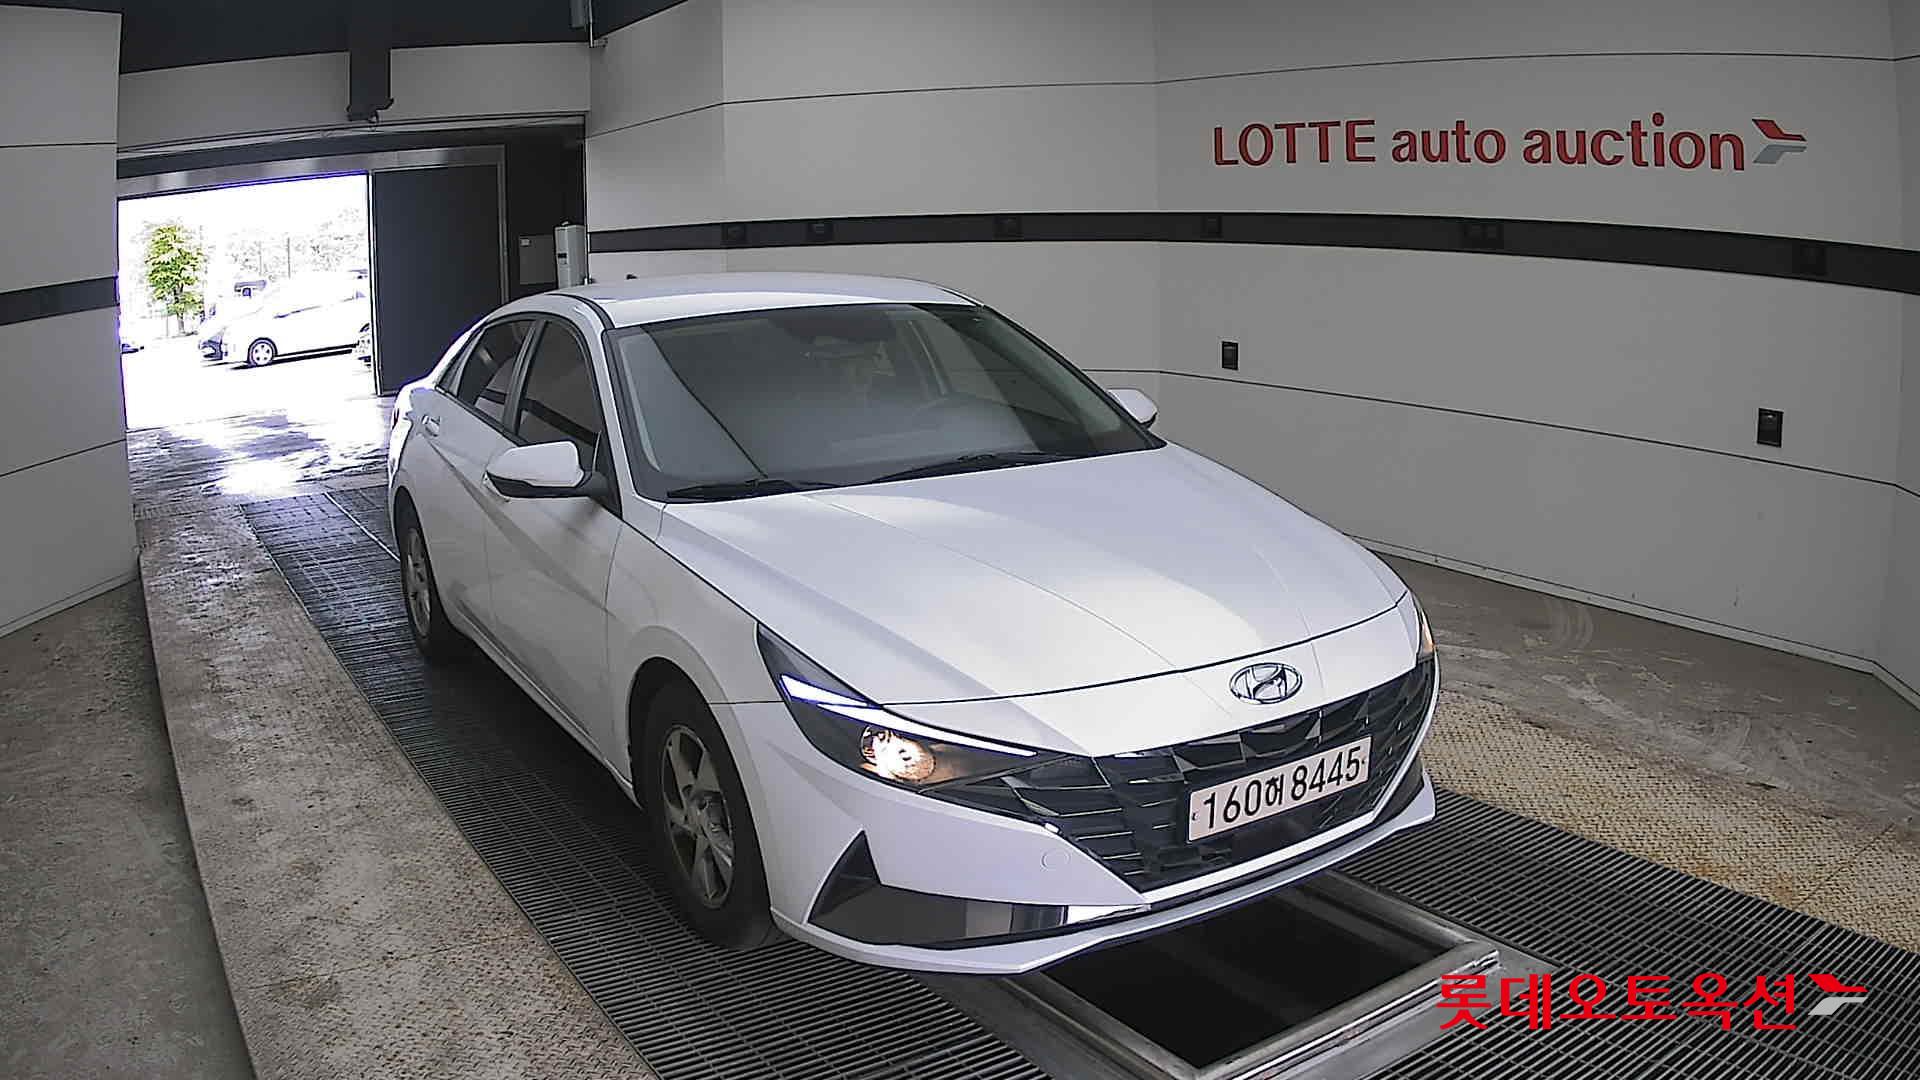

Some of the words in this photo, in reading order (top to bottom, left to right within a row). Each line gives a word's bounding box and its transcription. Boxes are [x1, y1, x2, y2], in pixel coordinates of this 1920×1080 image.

[1213, 119, 1376, 166] LOTTE
[1391, 119, 1506, 164] auto
[1522, 112, 1745, 171] auction
[1203, 774, 1285, 829] 160허
[1291, 746, 1361, 801] 8445
